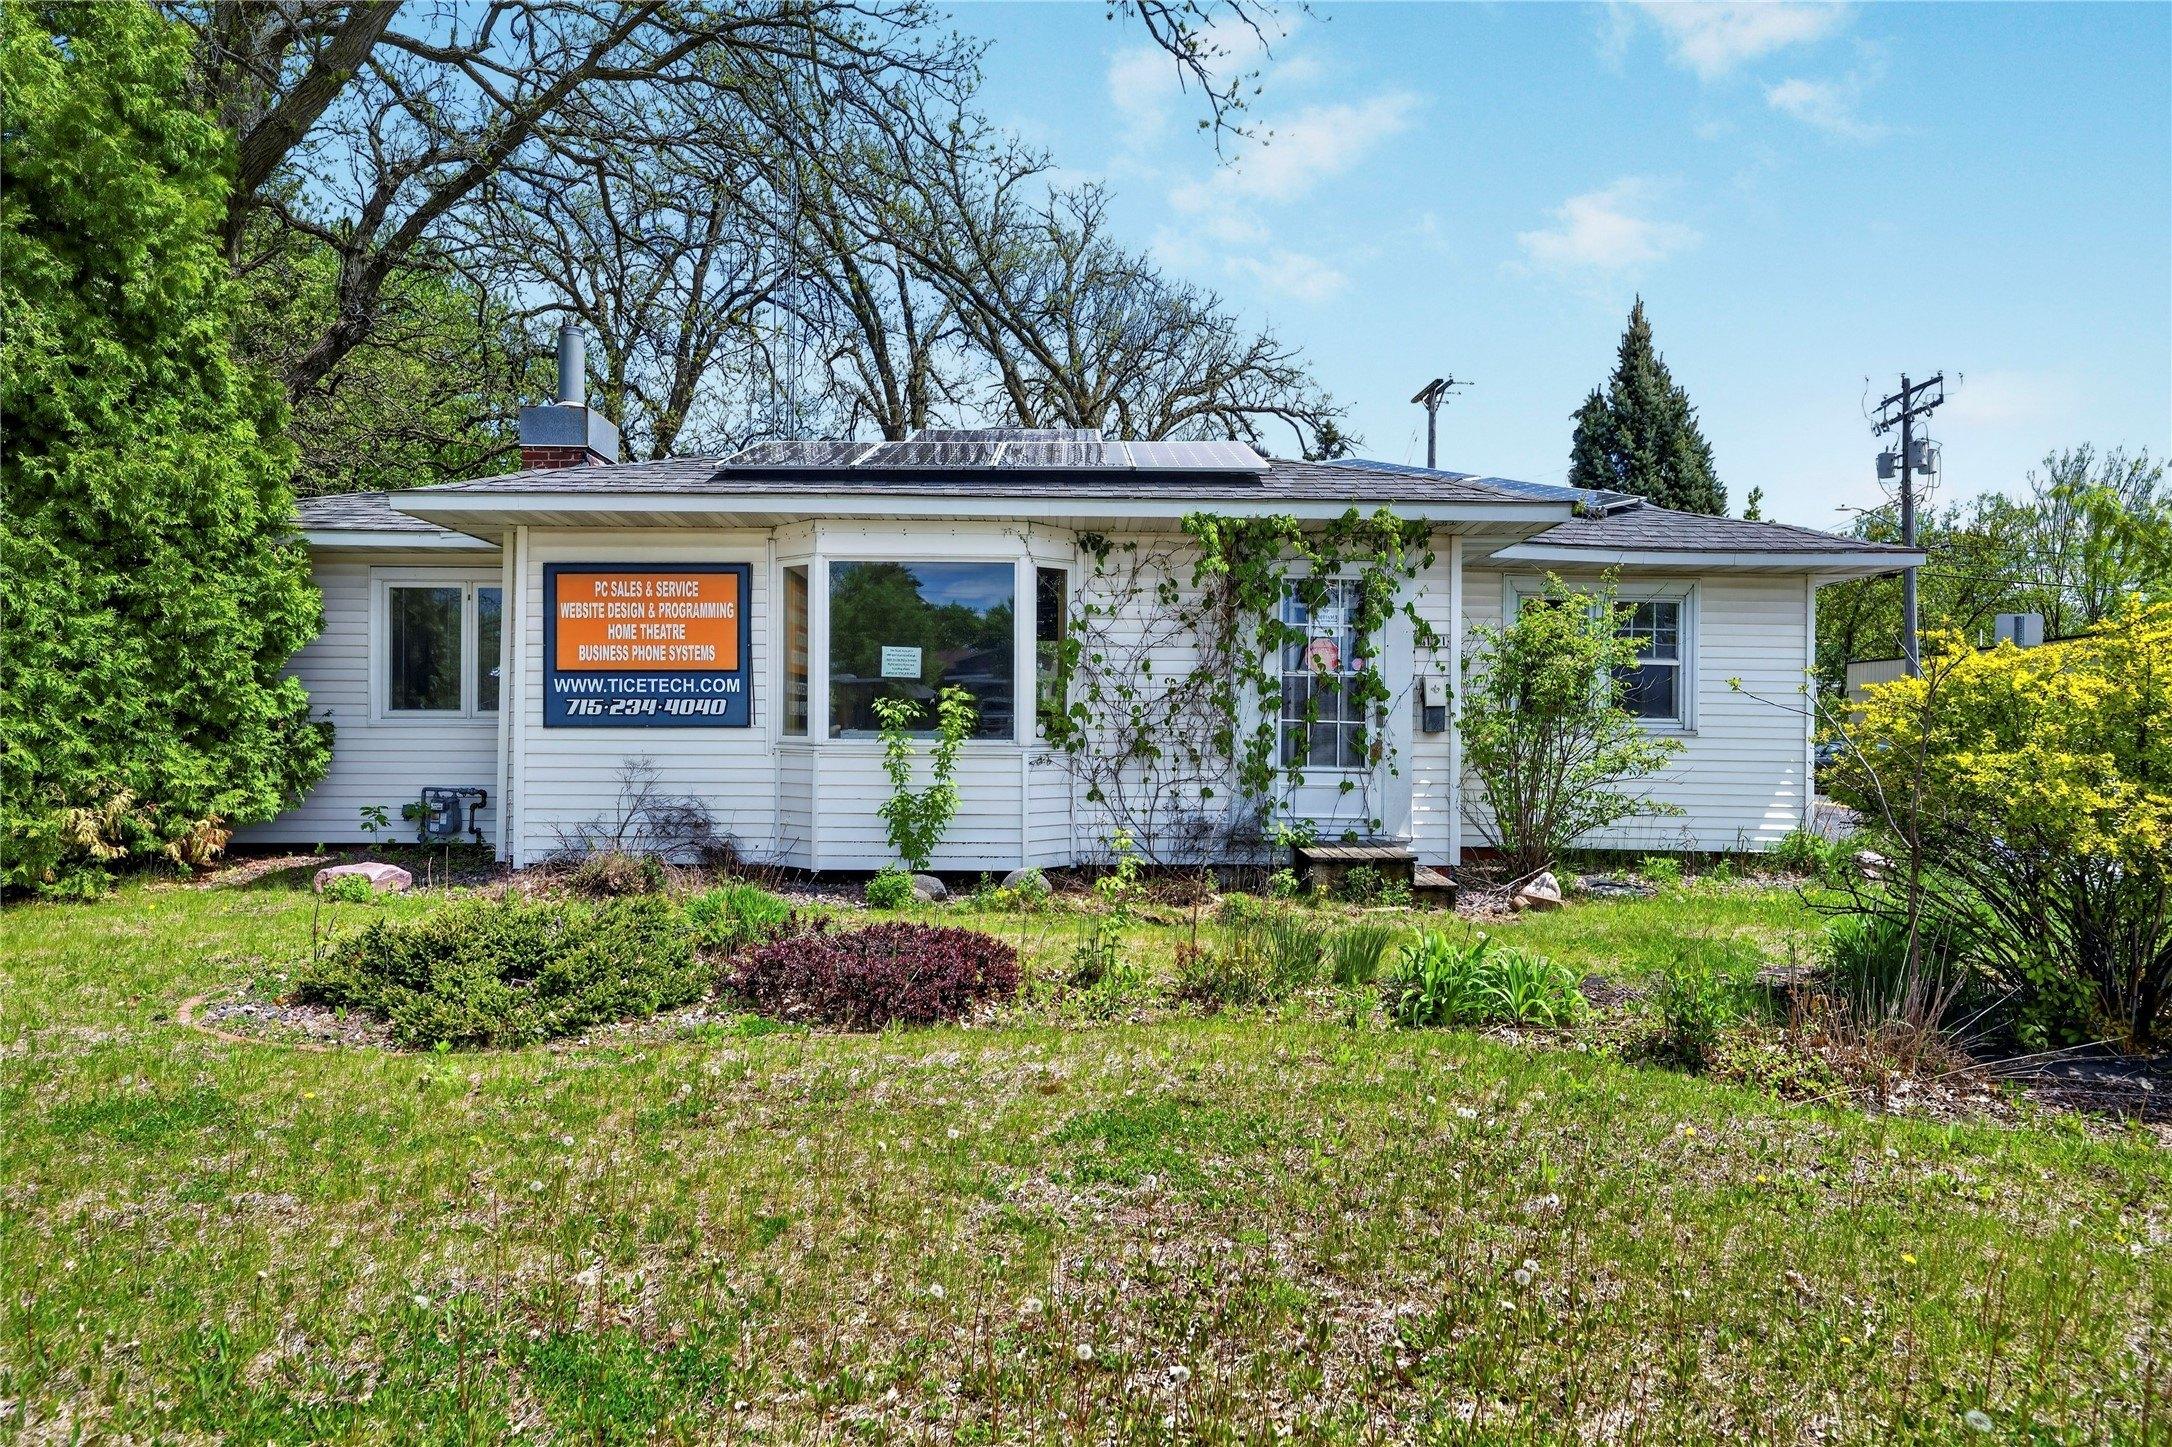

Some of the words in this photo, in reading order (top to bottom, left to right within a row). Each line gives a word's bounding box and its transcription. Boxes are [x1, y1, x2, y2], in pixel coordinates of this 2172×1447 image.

[595, 581, 608, 597] PC
[611, 581, 642, 597] SALES
[646, 581, 652, 597] &
[656, 581, 698, 597] SERVICE
[560, 603, 604, 618] WEBSITE
[608, 603, 645, 618] DESIGN
[648, 603, 655, 618] &
[659, 603, 734, 618] PROGRAMMING
[608, 624, 637, 639] HOME
[640, 624, 685, 639] THEATRE
[579, 645, 628, 661] BUSINESS
[632, 645, 666, 661] PHONE
[669, 645, 715, 661] SYSTEMS
[554, 678, 740, 693] WWW.TICETECH.COM
